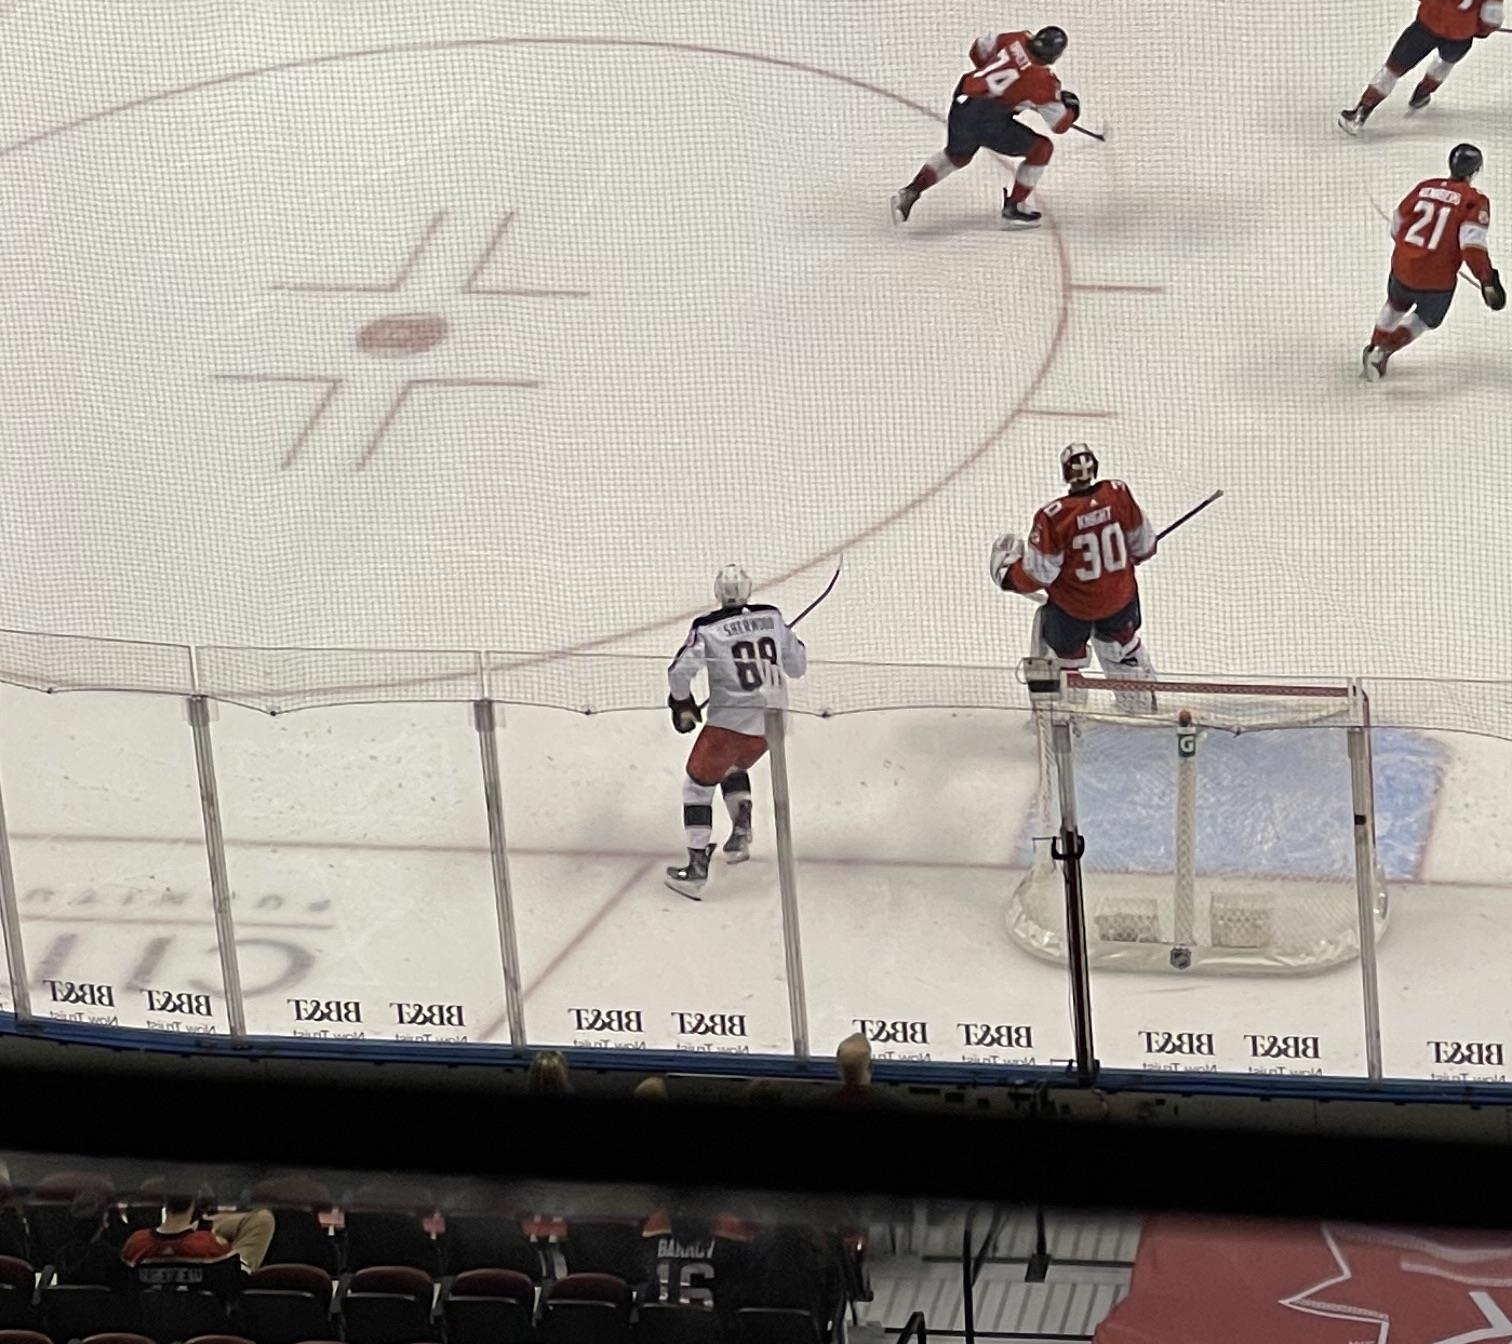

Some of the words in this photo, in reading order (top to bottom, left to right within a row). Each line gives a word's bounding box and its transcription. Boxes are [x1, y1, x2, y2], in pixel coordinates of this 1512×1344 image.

[1404, 200, 1451, 251] 21
[1072, 522, 1128, 582] 30
[1180, 736, 1195, 754] G
